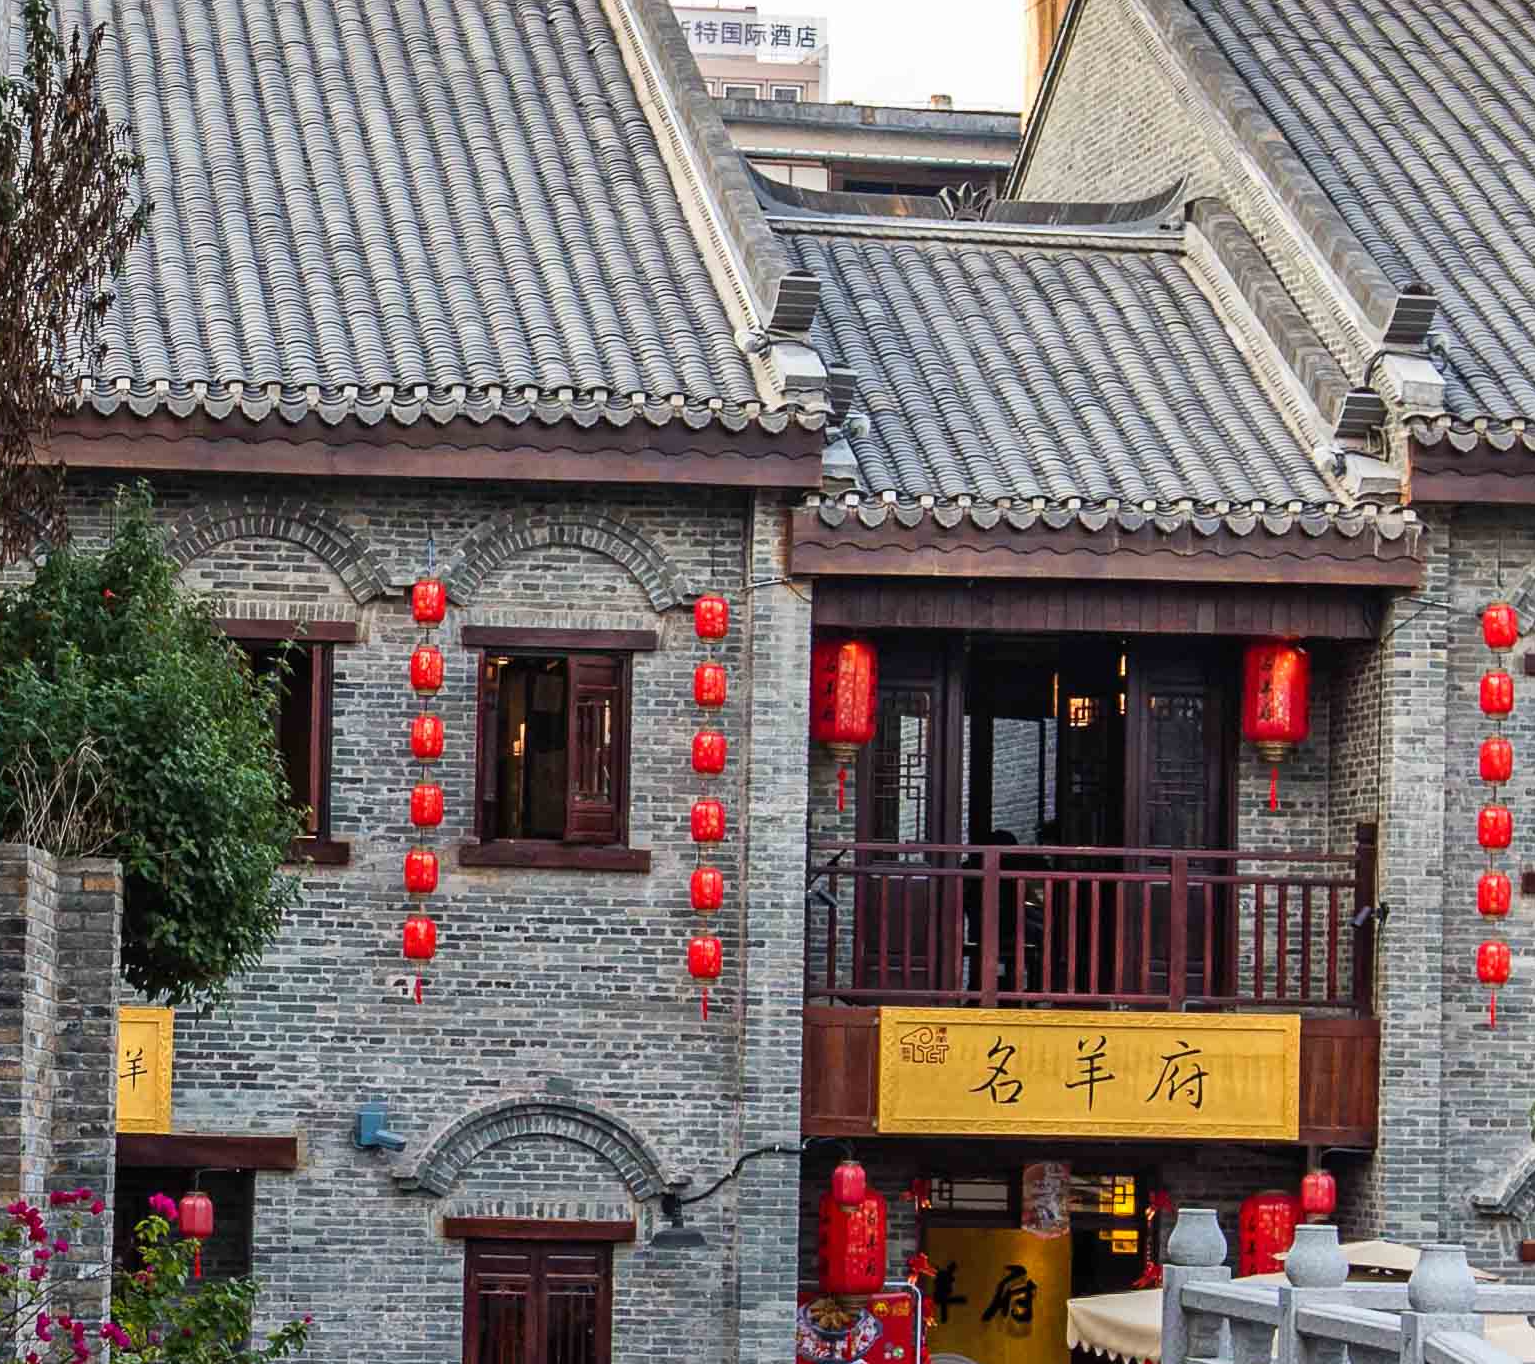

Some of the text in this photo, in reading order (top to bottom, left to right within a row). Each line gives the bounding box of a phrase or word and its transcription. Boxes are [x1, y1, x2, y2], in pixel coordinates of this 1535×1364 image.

[120, 1047, 148, 1092] 羊
[969, 1035, 1209, 1112] 名羊府
